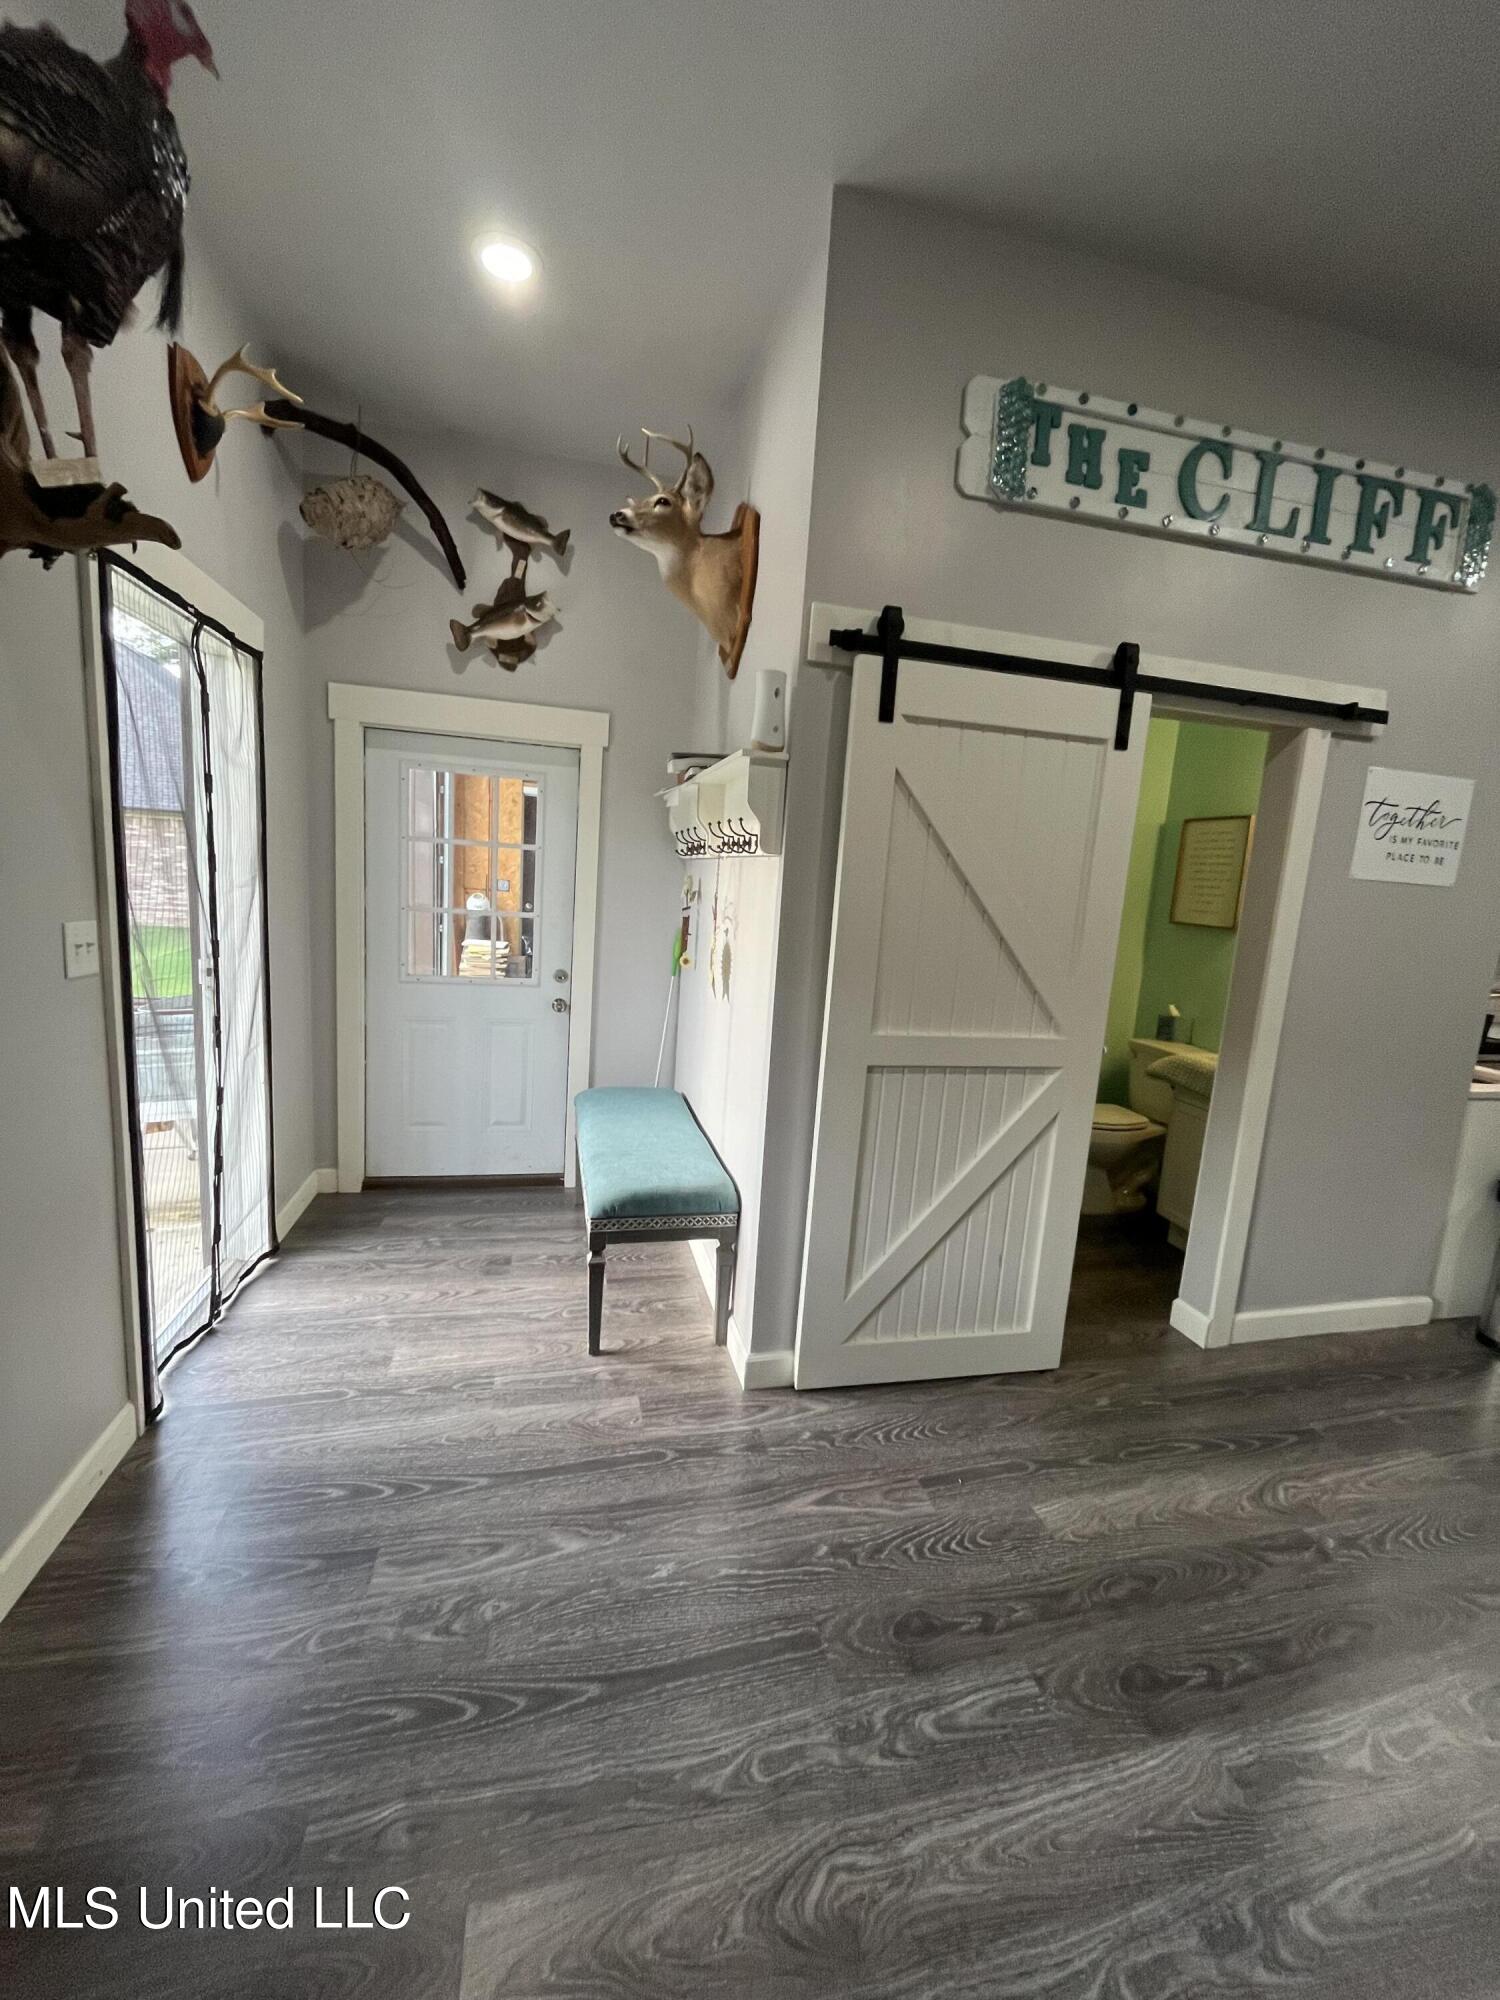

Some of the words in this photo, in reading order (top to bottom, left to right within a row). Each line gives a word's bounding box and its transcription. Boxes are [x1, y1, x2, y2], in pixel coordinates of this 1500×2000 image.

[1030, 398, 1150, 509] THE
[1177, 439, 1462, 566] CLIFF
[1389, 835, 1398, 844] IS
[1417, 837, 1460, 851] FAVORITE
[1385, 852, 1415, 863] PLACE
[1419, 854, 1431, 865] TO
[1434, 856, 1445, 866] BE
